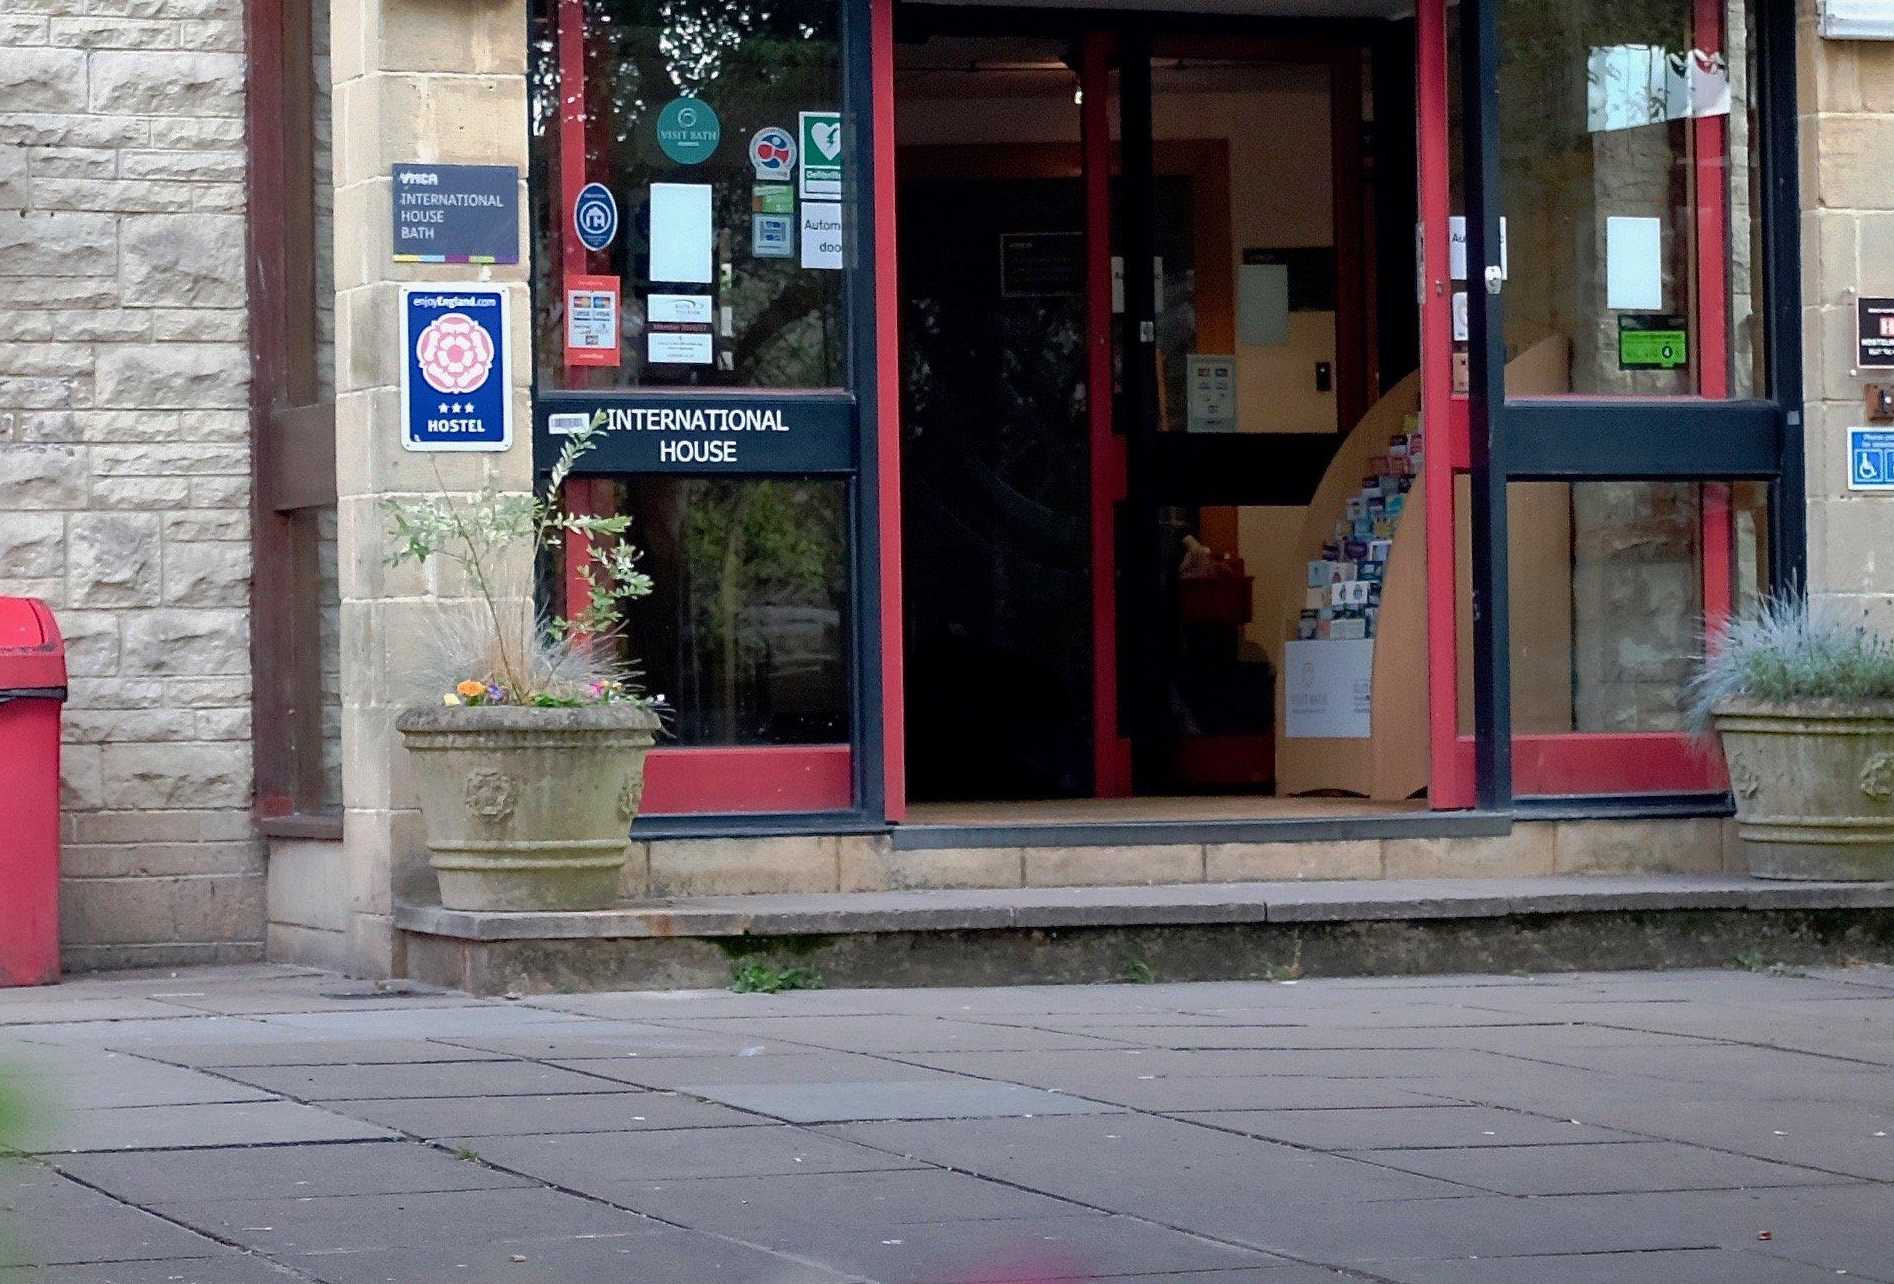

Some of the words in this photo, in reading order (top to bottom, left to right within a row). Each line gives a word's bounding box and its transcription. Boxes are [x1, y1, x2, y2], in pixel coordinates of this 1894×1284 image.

[689, 130, 716, 141] BATH
[400, 172, 438, 185] YMCA
[400, 193, 504, 207] INTERNATIONAL
[401, 210, 444, 223] HOUSE
[401, 226, 435, 239] BATH
[427, 419, 486, 433] HOSTEL
[606, 409, 790, 431] INTERNATIONAL
[660, 440, 737, 462] HOUSE
